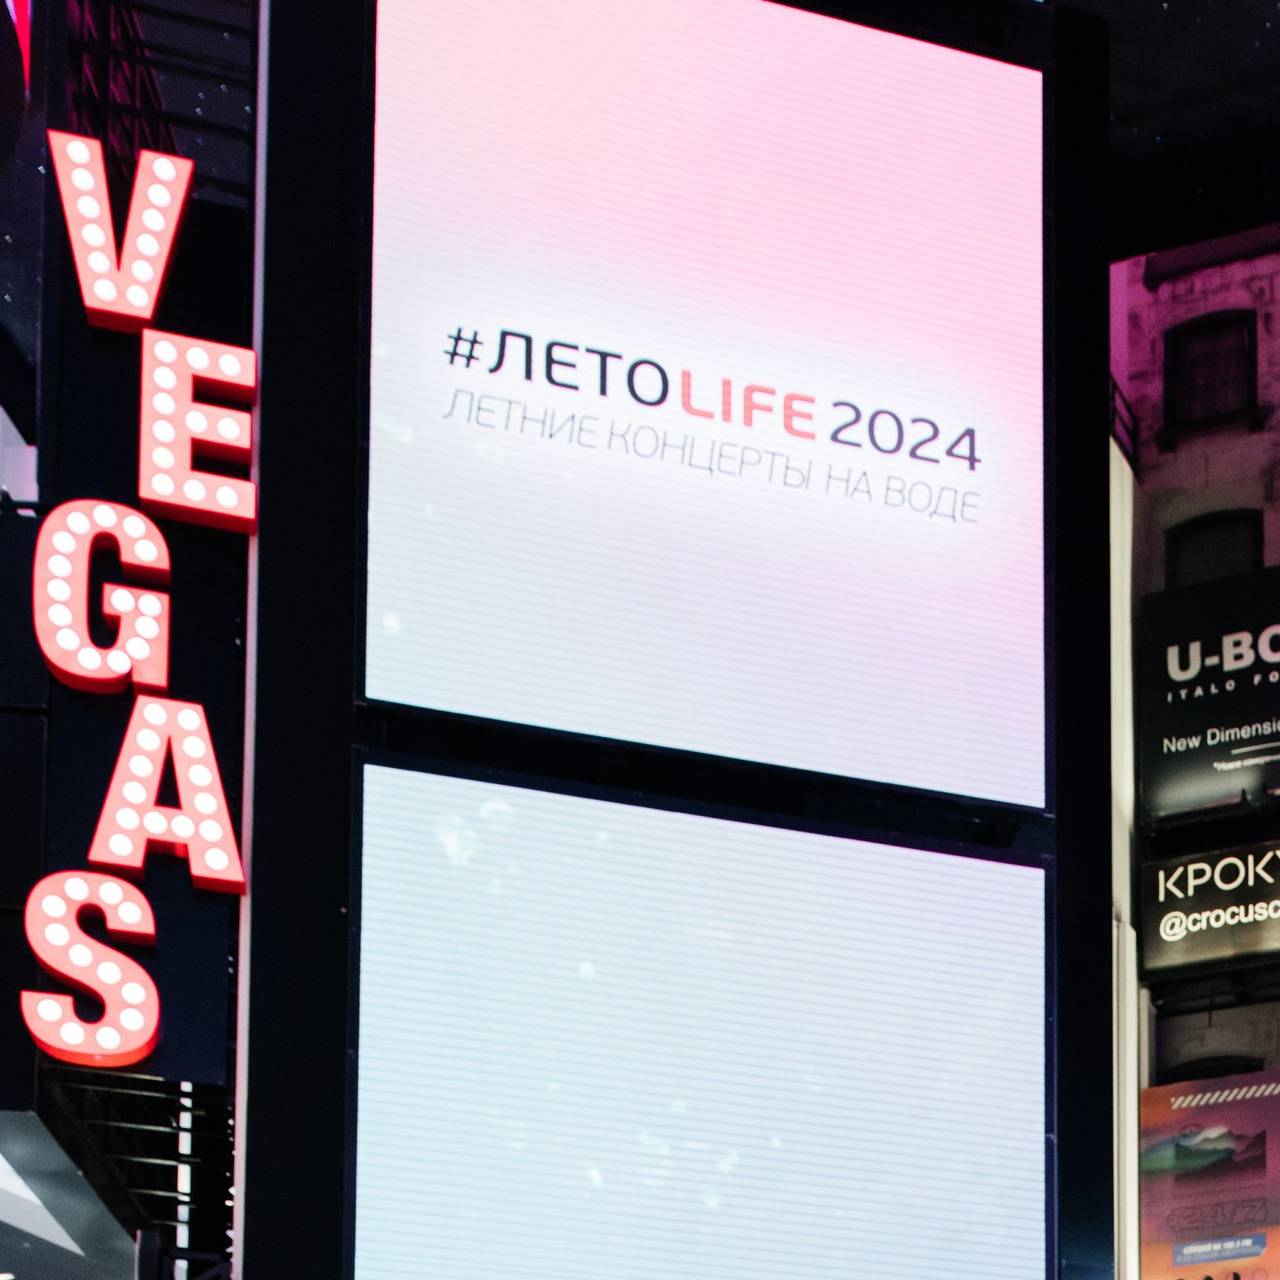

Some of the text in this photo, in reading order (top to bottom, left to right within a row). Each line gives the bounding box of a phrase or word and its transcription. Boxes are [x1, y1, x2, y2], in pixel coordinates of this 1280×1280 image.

[442, 388, 981, 524] ЛЕТНИЕ КОНЦЕРТЫ НА ВОДЕ
[20, 130, 258, 1066] VEGAS
[1167, 679, 1236, 703] ITALO
[1163, 735, 1201, 754] New
